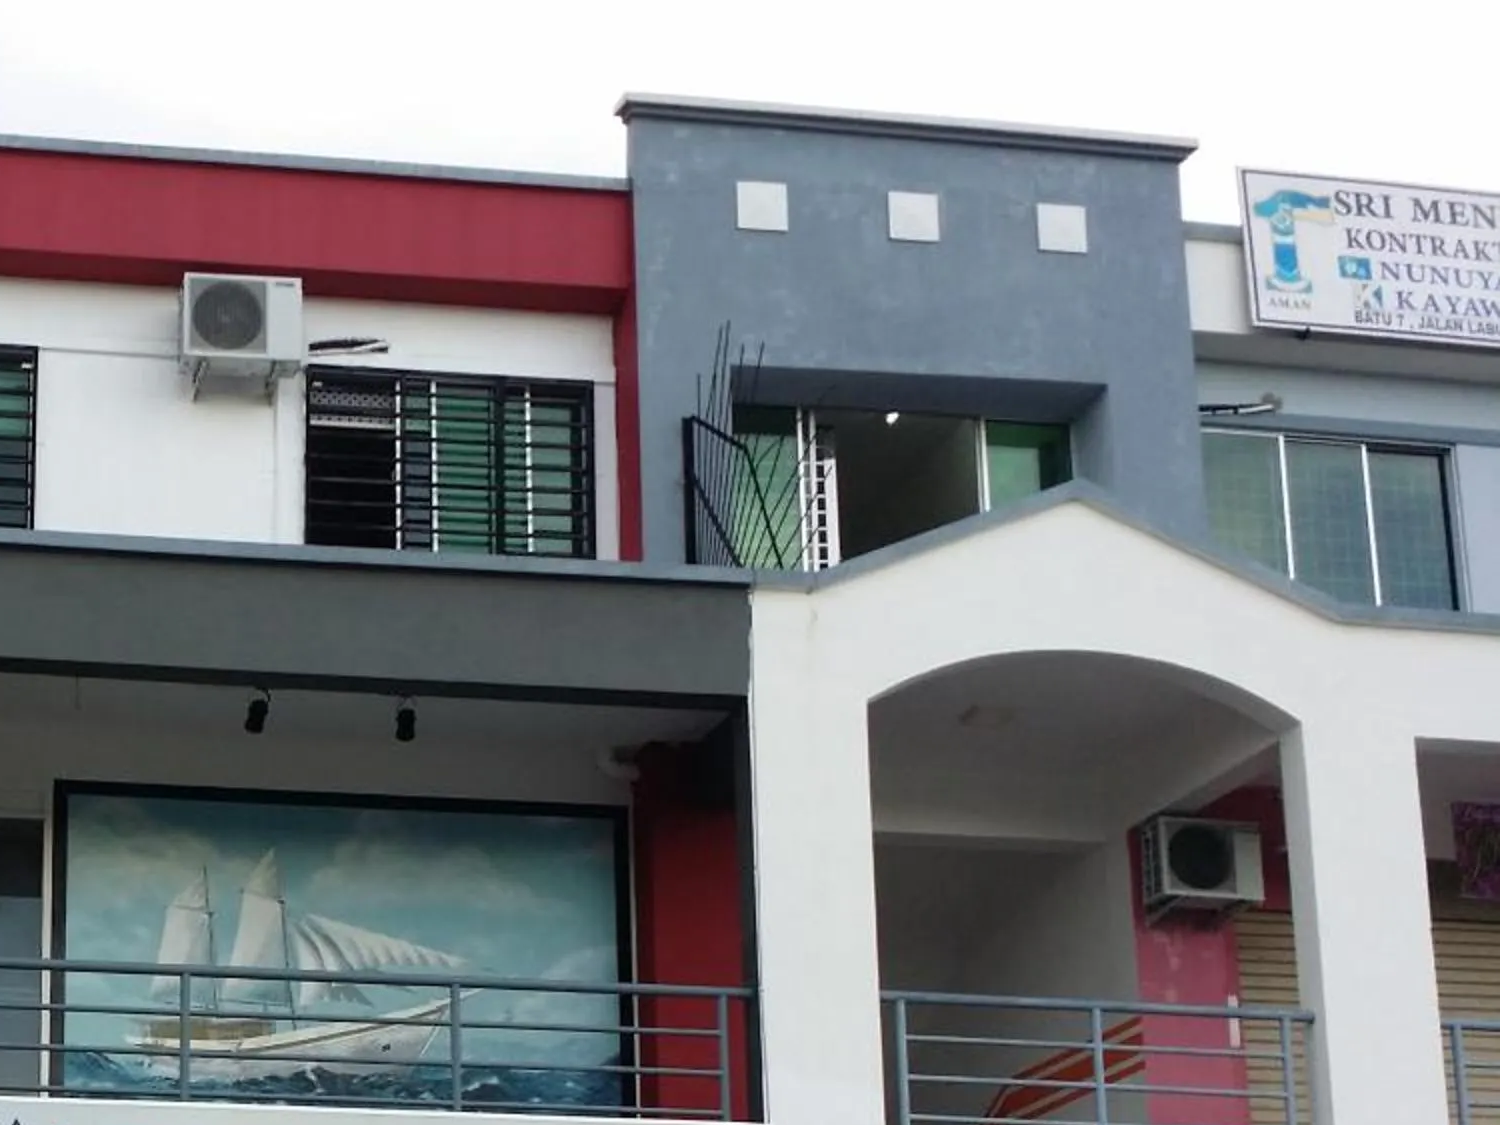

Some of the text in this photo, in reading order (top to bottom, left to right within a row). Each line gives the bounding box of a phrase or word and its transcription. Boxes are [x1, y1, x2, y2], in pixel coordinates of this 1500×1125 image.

[1333, 189, 1499, 230] SRI MEN
[1354, 310, 1393, 326] BATU
[1419, 315, 1464, 333] JALAN
